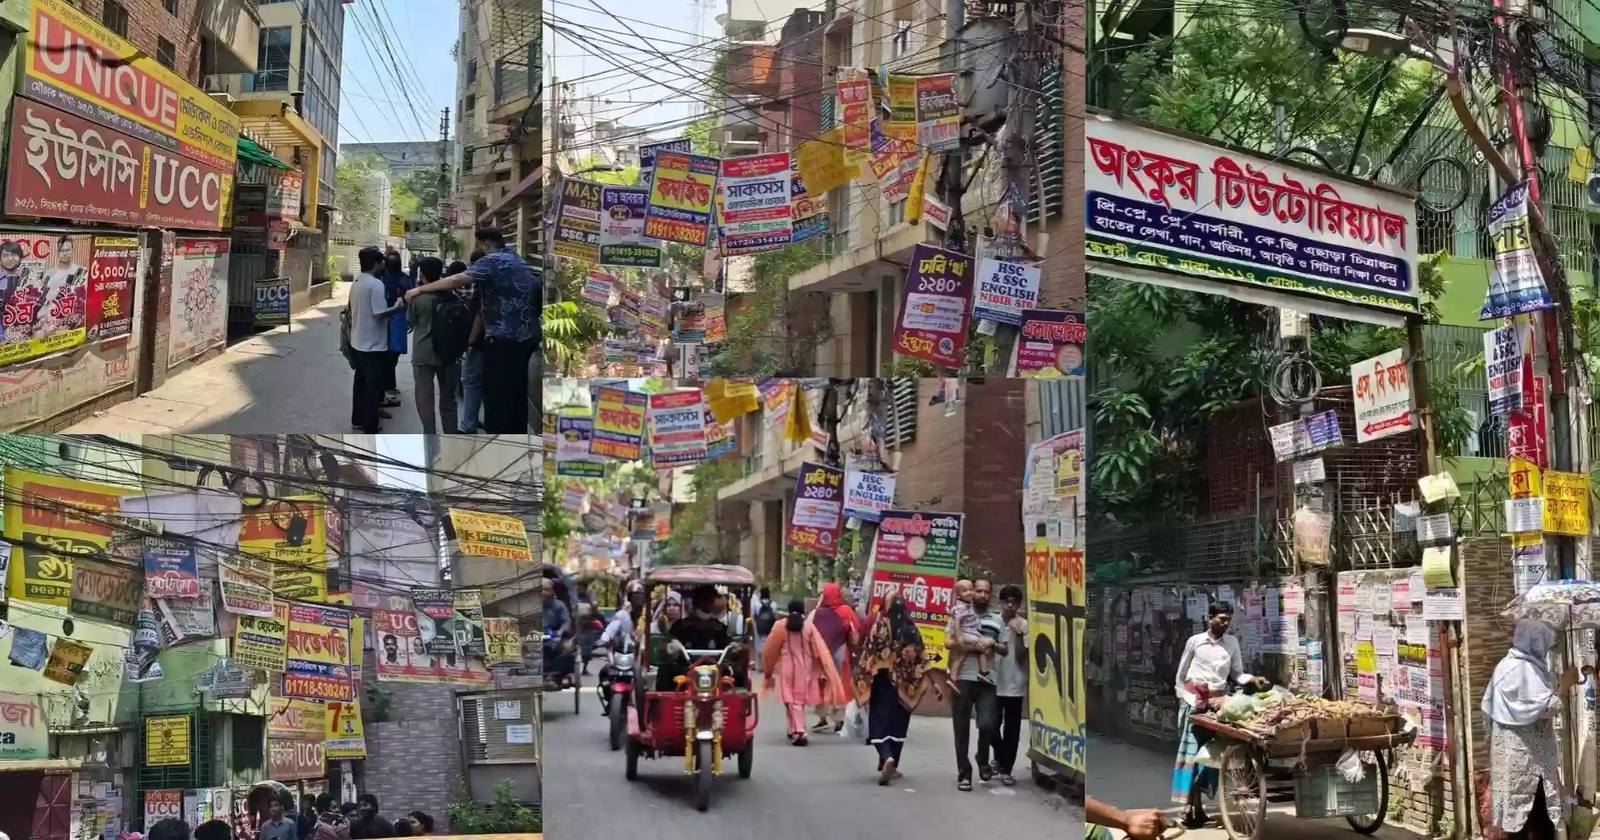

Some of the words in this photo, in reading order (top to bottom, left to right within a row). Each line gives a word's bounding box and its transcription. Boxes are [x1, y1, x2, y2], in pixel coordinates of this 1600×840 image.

[38, 14, 177, 128] UNIQUE
[22, 108, 140, 199] ইউসিসি
[153, 153, 220, 212] UCC
[1086, 136, 1202, 214] অংকুর
[566, 182, 600, 200] MAS
[728, 180, 785, 198] সাকসেস
[580, 200, 598, 210] SIR
[1194, 220, 1248, 243] নার্সারী,
[1304, 246, 1345, 262] এছাড়া
[94, 249, 128, 258] Advanced
[1096, 215, 1136, 234] হাতের
[1140, 226, 1174, 243] লেখা,
[1180, 234, 1205, 250] গান,
[1210, 240, 1256, 260] অভিনয়,
[1260, 250, 1294, 268] আবৃত্তি
[1298, 260, 1306, 268] ও
[1310, 260, 1340, 275] গিটার
[1344, 266, 1370, 282] শিক্ষা
[1374, 274, 1398, 288] কেন্দ্র
[1136, 250, 1170, 266] রোড
[919, 254, 948, 275] ঢাবি
[998, 263, 1024, 277] HSC
[992, 273, 1000, 283] &
[1003, 274, 1028, 288] SSC
[256, 286, 289, 301] UCC
[981, 282, 1036, 301] ENGLISH
[980, 292, 1011, 306] NIBIR
[1015, 300, 1035, 310] SIR
[1495, 328, 1514, 344] HSC
[1500, 342, 1516, 360] SSC
[1488, 356, 1521, 378] ENGLISH
[1375, 360, 1386, 398] বি
[654, 411, 699, 424] সাকসেস
[857, 482, 865, 490] &
[866, 484, 886, 494] SSC
[862, 474, 884, 486] HSC
[849, 489, 892, 504] ENGLISH
[480, 532, 527, 546] Fingers
[286, 680, 350, 699] 01718-530247
[270, 740, 294, 768] ইউসিসি
[296, 742, 320, 767] UCC
[146, 802, 180, 816] UCC
